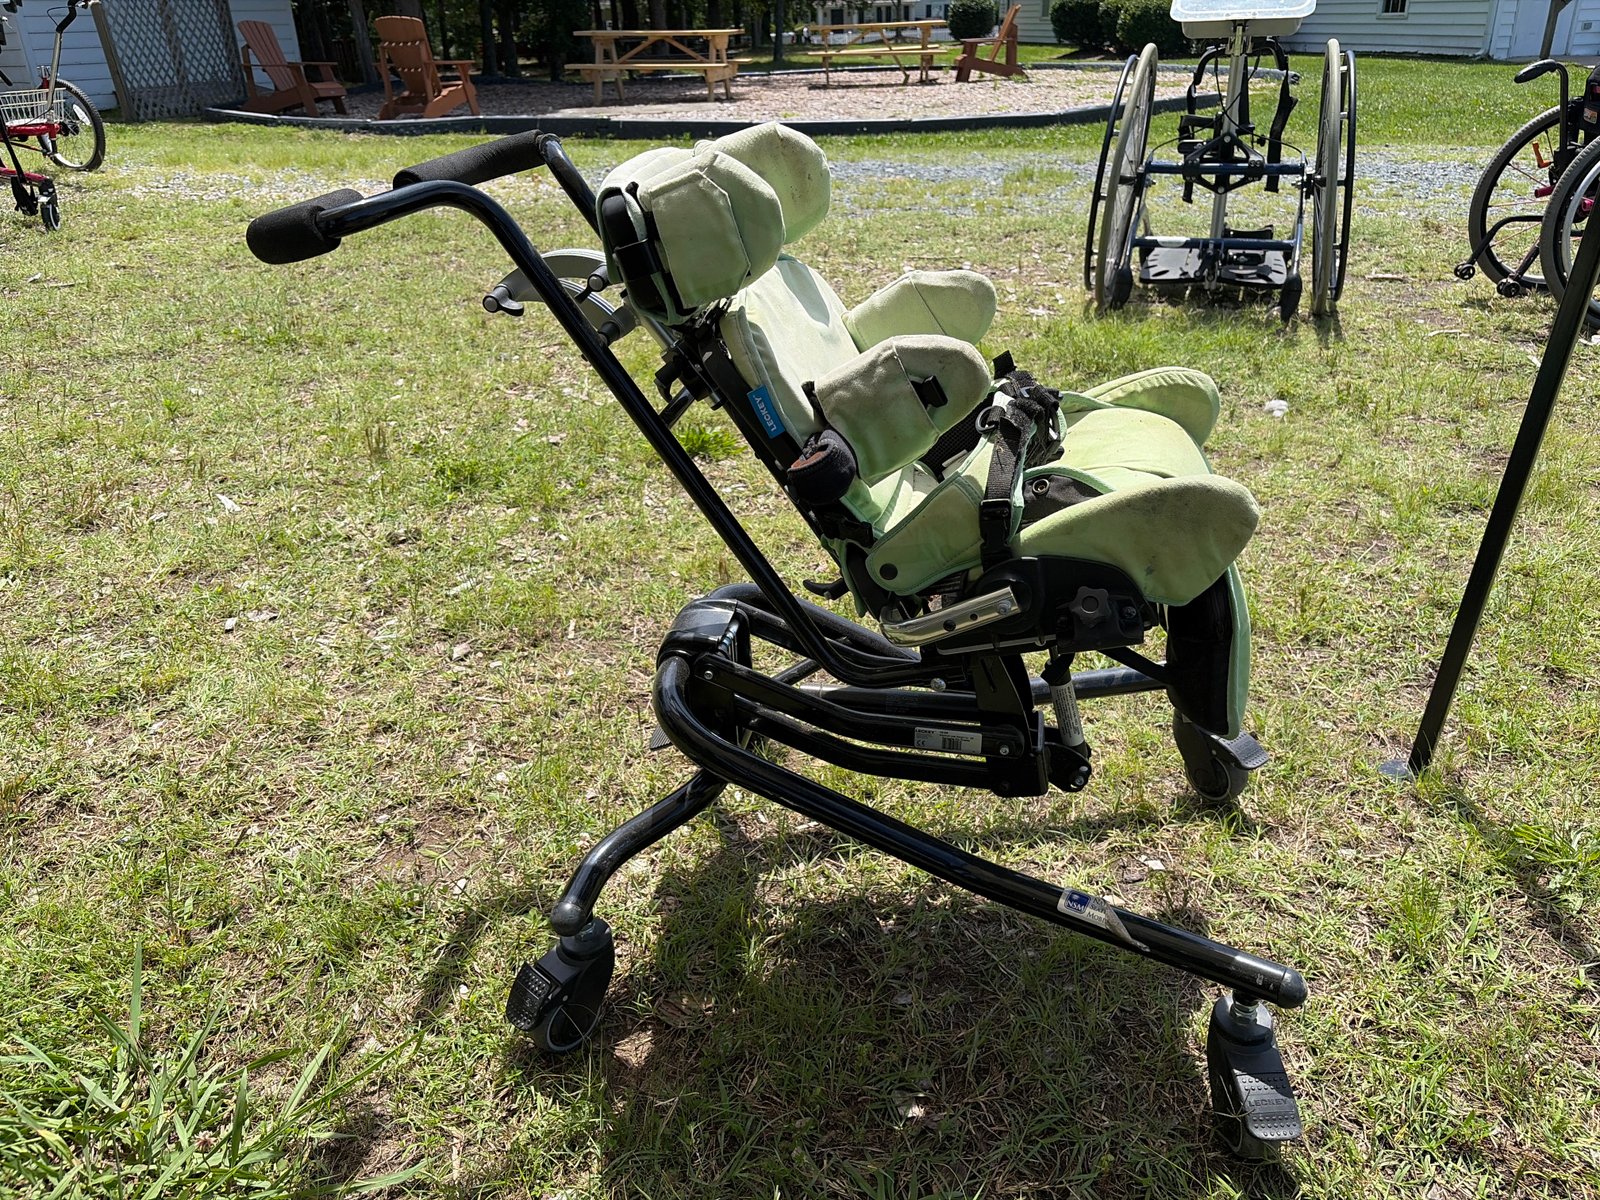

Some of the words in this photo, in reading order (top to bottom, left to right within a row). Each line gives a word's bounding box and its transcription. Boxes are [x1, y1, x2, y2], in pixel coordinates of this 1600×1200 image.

[754, 396, 777, 432] LECKEY
[1067, 900, 1085, 911] NSM
[1248, 1098, 1288, 1107] LECKEY
